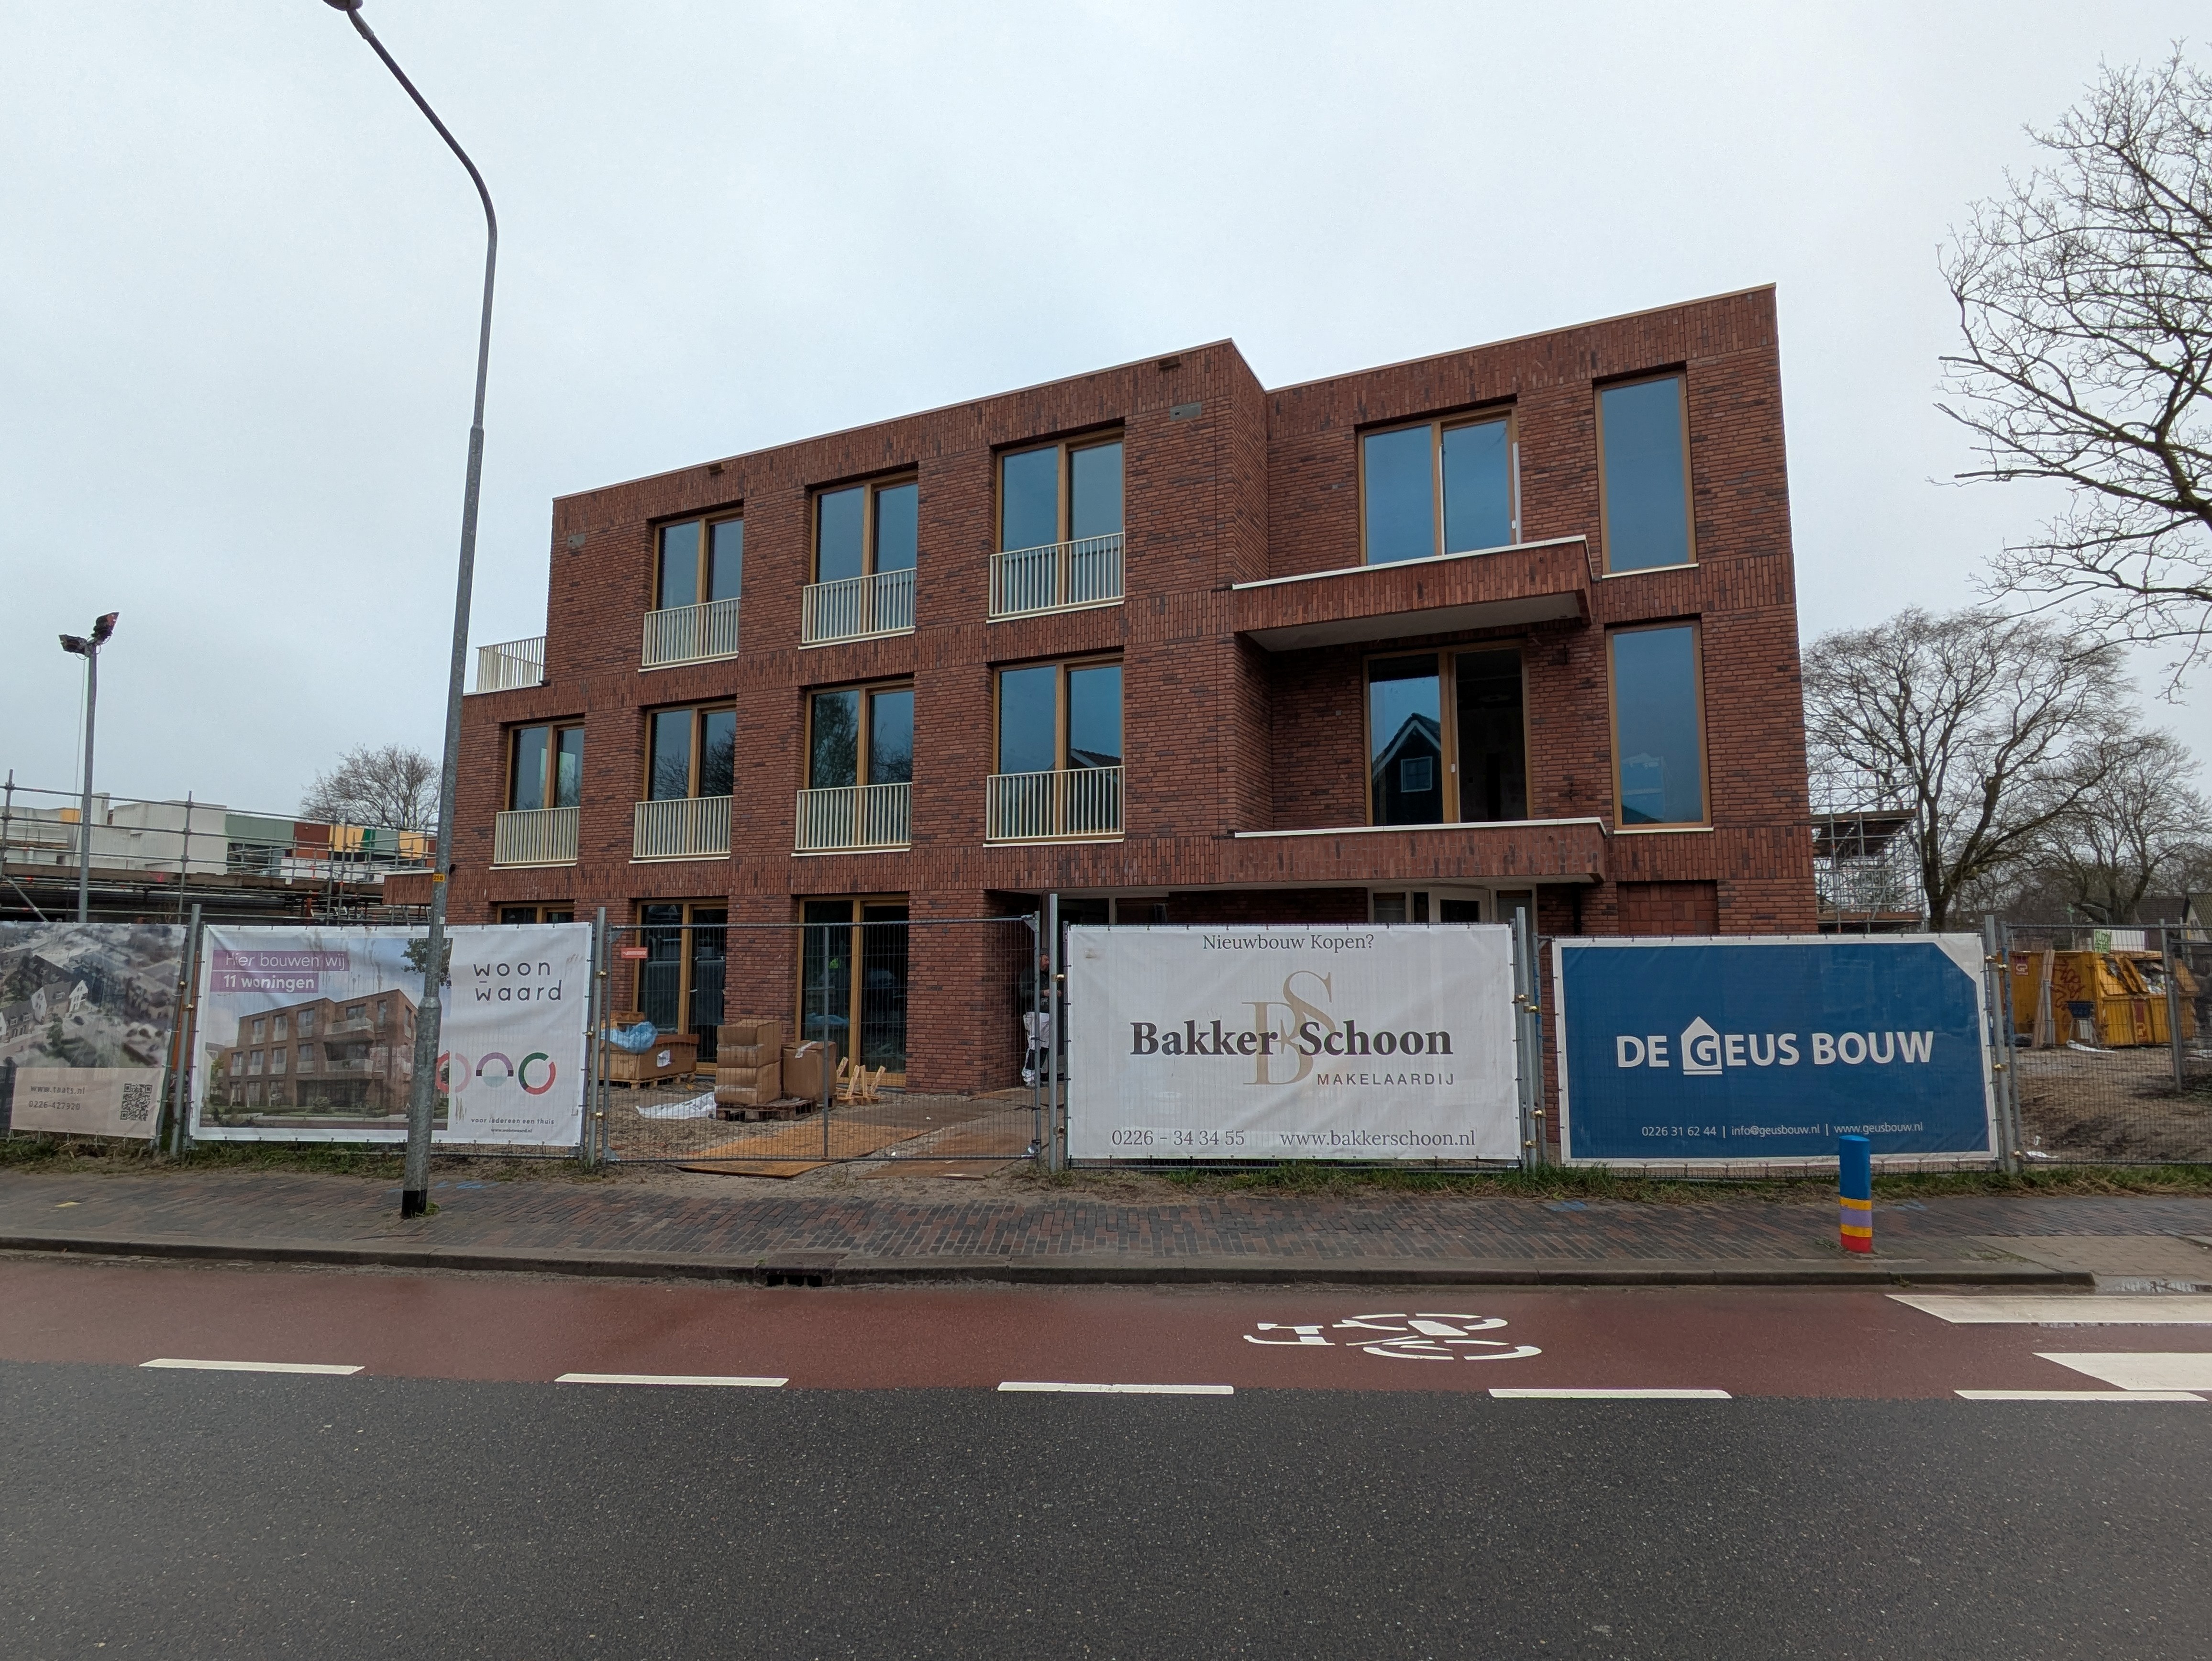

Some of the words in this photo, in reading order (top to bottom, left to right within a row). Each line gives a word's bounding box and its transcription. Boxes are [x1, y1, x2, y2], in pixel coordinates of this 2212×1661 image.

[1203, 934, 1305, 950] Nieuwbouw
[1310, 934, 1374, 953] Kopen?
[226, 952, 255, 966] Hier
[260, 952, 320, 967] bouwen
[325, 953, 345, 971] wij
[473, 962, 551, 977] woon
[223, 974, 236, 988] 11
[241, 974, 315, 993] woningen
[475, 979, 563, 1001] waard
[1130, 1019, 1278, 1056] Bakker
[1298, 1019, 1454, 1056] Schoon
[1616, 1035, 1670, 1068] DE
[1689, 1033, 1800, 1067] GEUS
[1812, 1031, 1934, 1065] BOUW
[1317, 1073, 1454, 1085] MAKELAARDIJ
[29, 1100, 80, 1110] 0226-427920
[1111, 1129, 1154, 1146] 0226
[1173, 1129, 1194, 1146] 34
[1198, 1129, 1220, 1146] 34
[1224, 1129, 1245, 1146] 55
[1280, 1129, 1475, 1146] www.bakkerschoon.nl
[1641, 1126, 1668, 1136] 0226
[1671, 1126, 1683, 1136] 31
[1687, 1126, 1700, 1136] 62
[1703, 1126, 1716, 1135] 44
[1731, 1124, 1820, 1138] info@geusbouw.nl
[1834, 1121, 1923, 1134] www.geusbouw.nl
